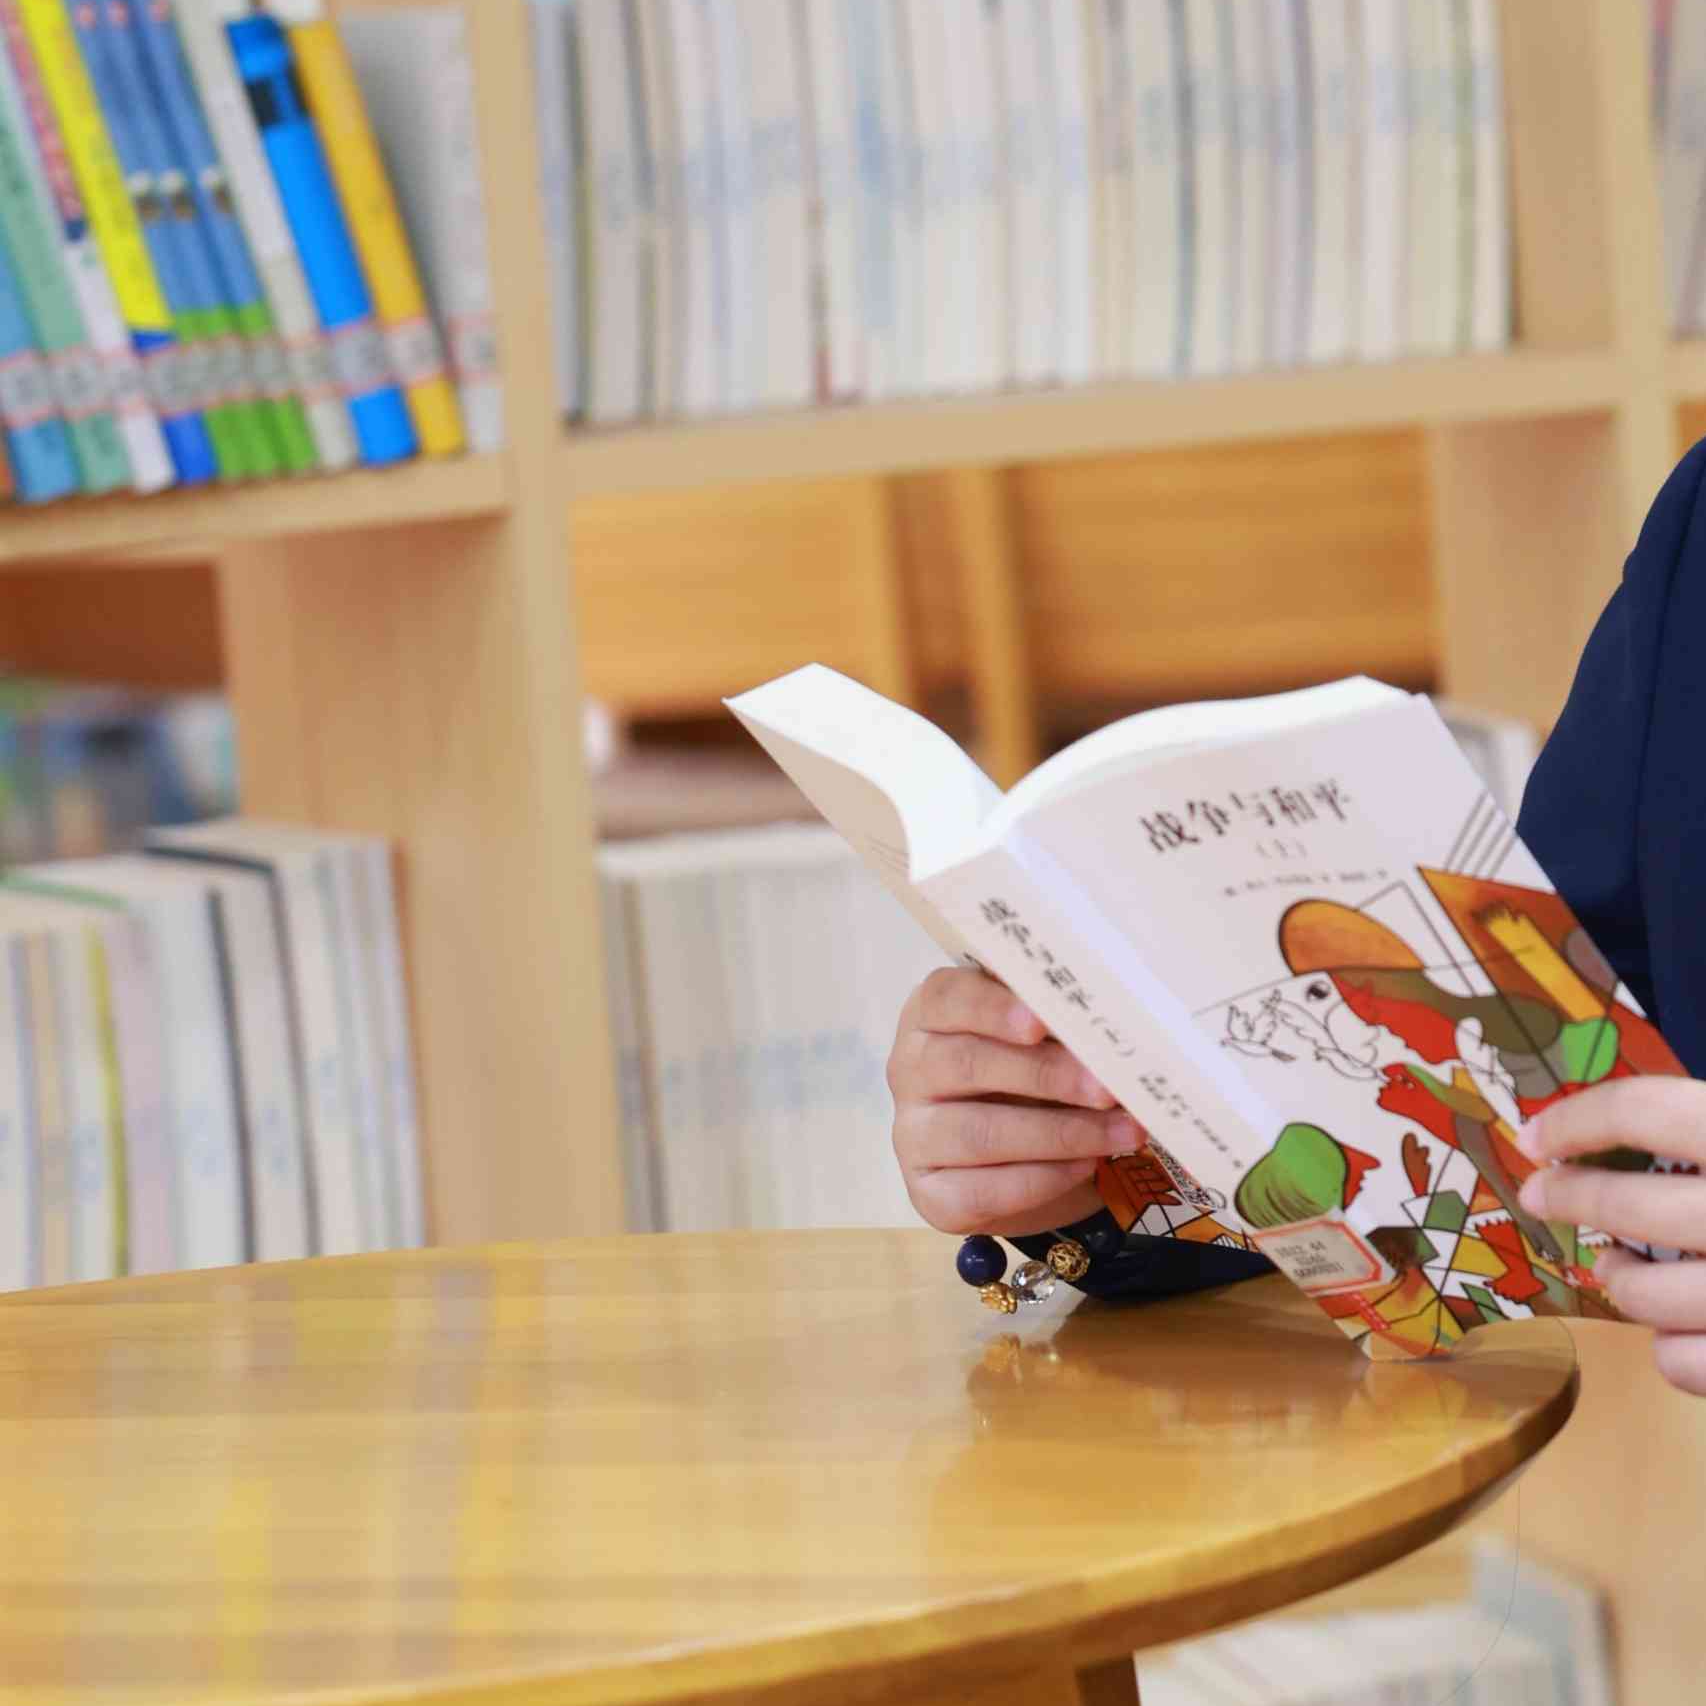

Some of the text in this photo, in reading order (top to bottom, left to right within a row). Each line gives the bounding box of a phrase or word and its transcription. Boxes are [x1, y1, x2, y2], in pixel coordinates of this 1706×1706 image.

[1139, 779, 1349, 853] 战争与和平
